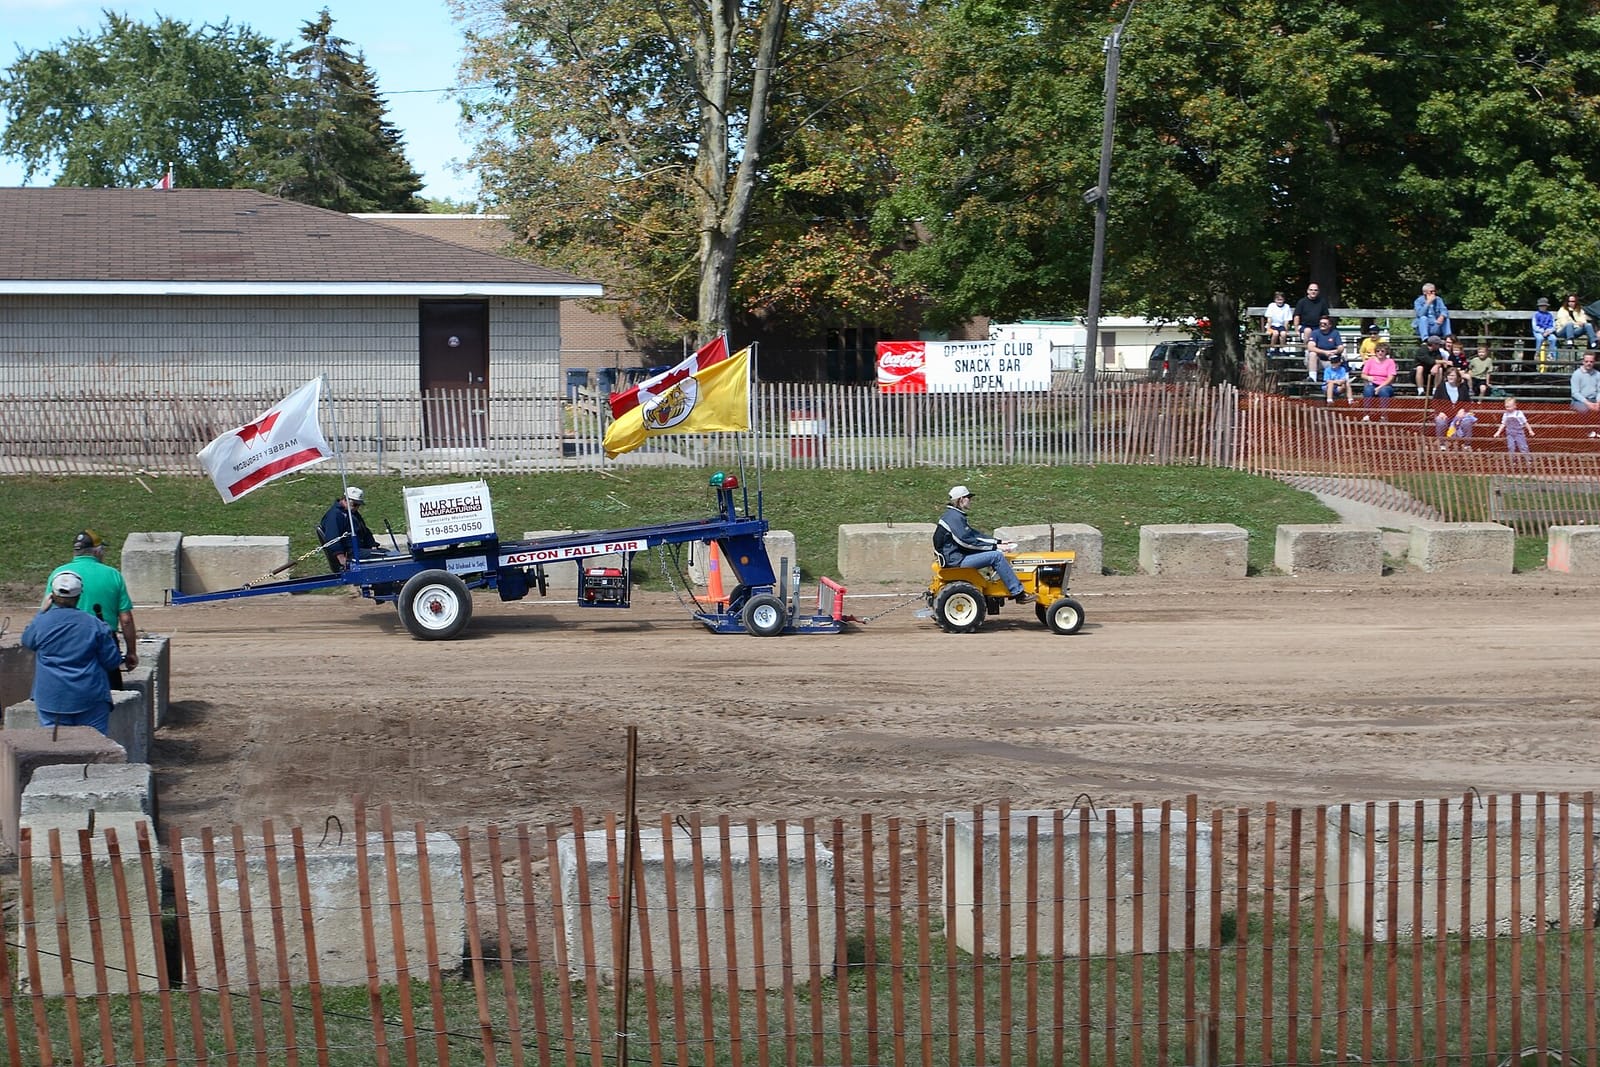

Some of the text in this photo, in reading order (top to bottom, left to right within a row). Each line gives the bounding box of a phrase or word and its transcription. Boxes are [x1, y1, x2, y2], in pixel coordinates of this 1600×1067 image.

[944, 342, 1033, 357] OPTIMIST CLUB
[955, 358, 1021, 373] SNACK BAR
[973, 375, 1003, 389] OPEN
[419, 495, 481, 511] MURTECH
[421, 504, 482, 517] MANUFACTURING
[425, 521, 482, 536] 519-853-0550
[506, 541, 639, 565] ACTON FALL FAIR
